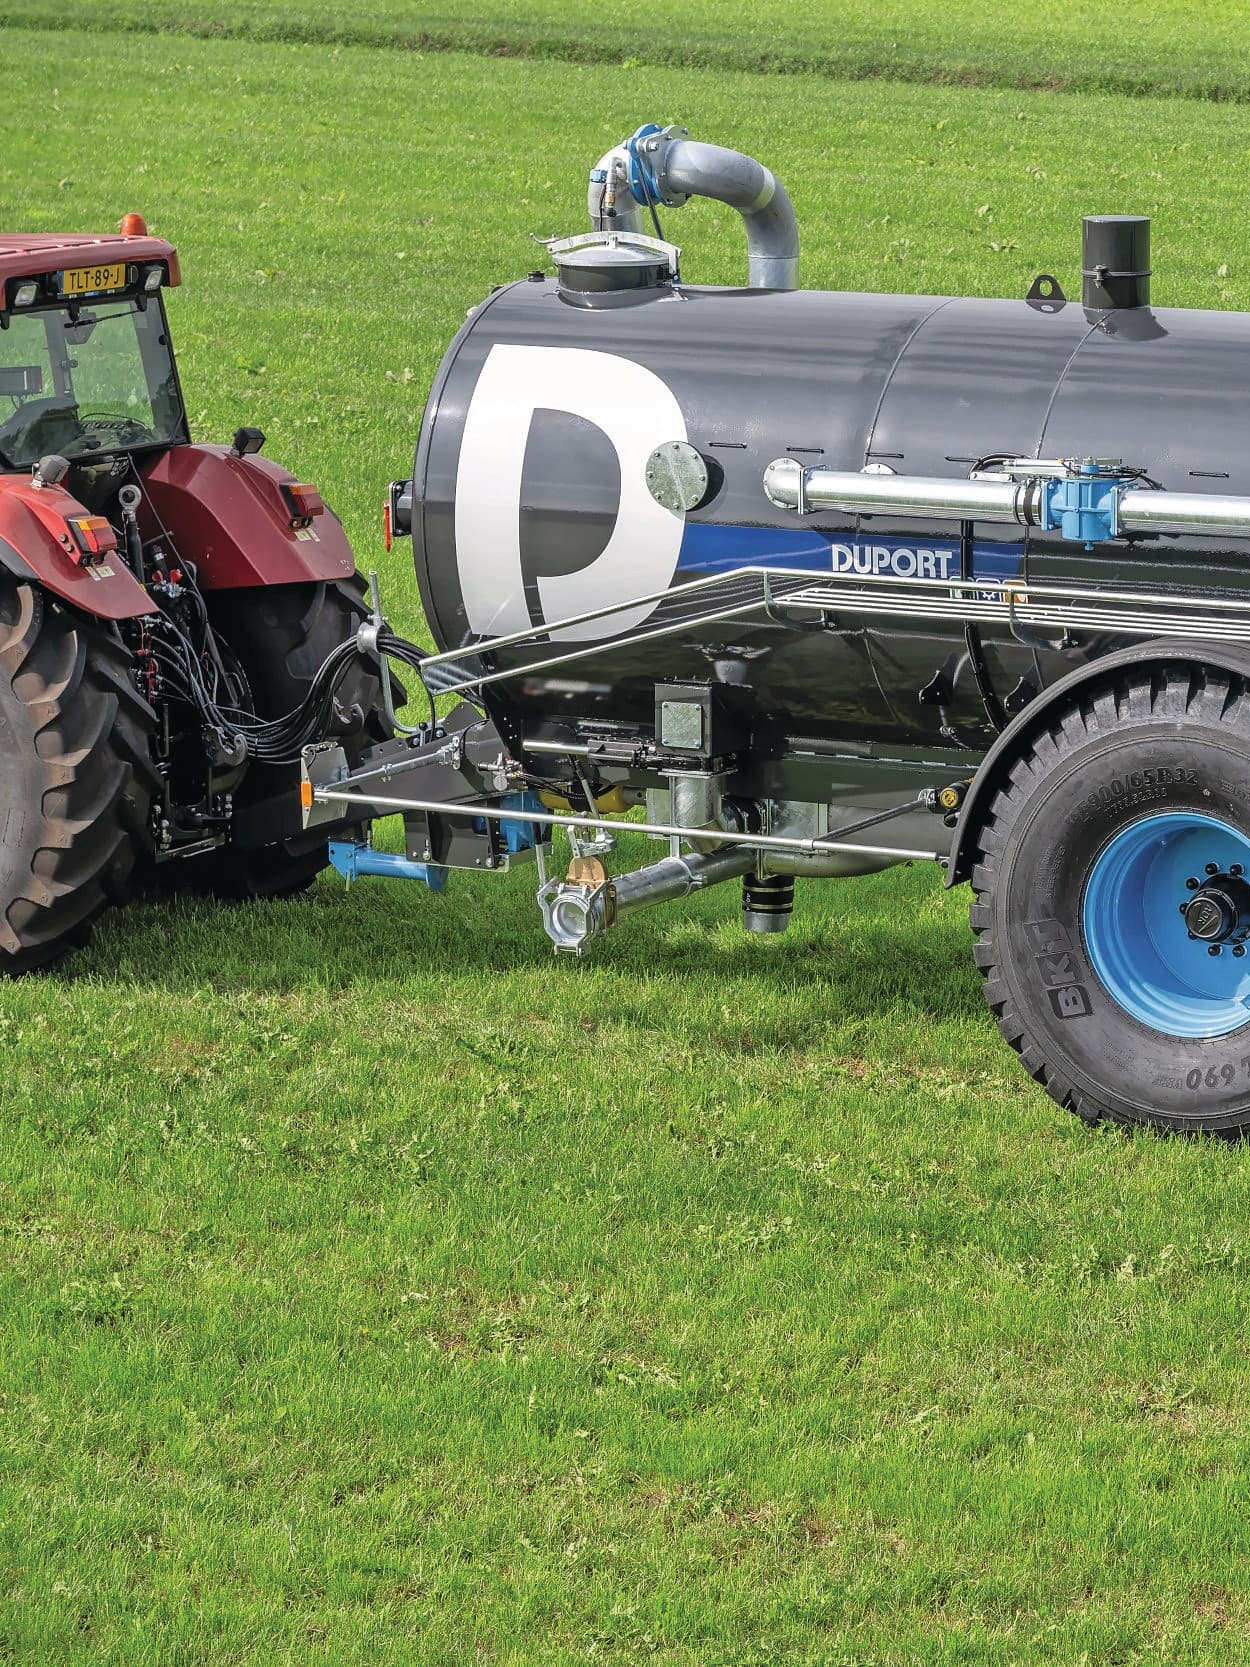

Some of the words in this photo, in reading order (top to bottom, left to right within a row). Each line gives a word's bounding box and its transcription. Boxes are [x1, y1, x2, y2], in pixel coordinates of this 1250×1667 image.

[70, 267, 119, 290] TLT-89-J
[831, 543, 953, 579] DUPORT
[1030, 922, 1088, 1017] BKT
[1186, 1064, 1236, 1091] 690
